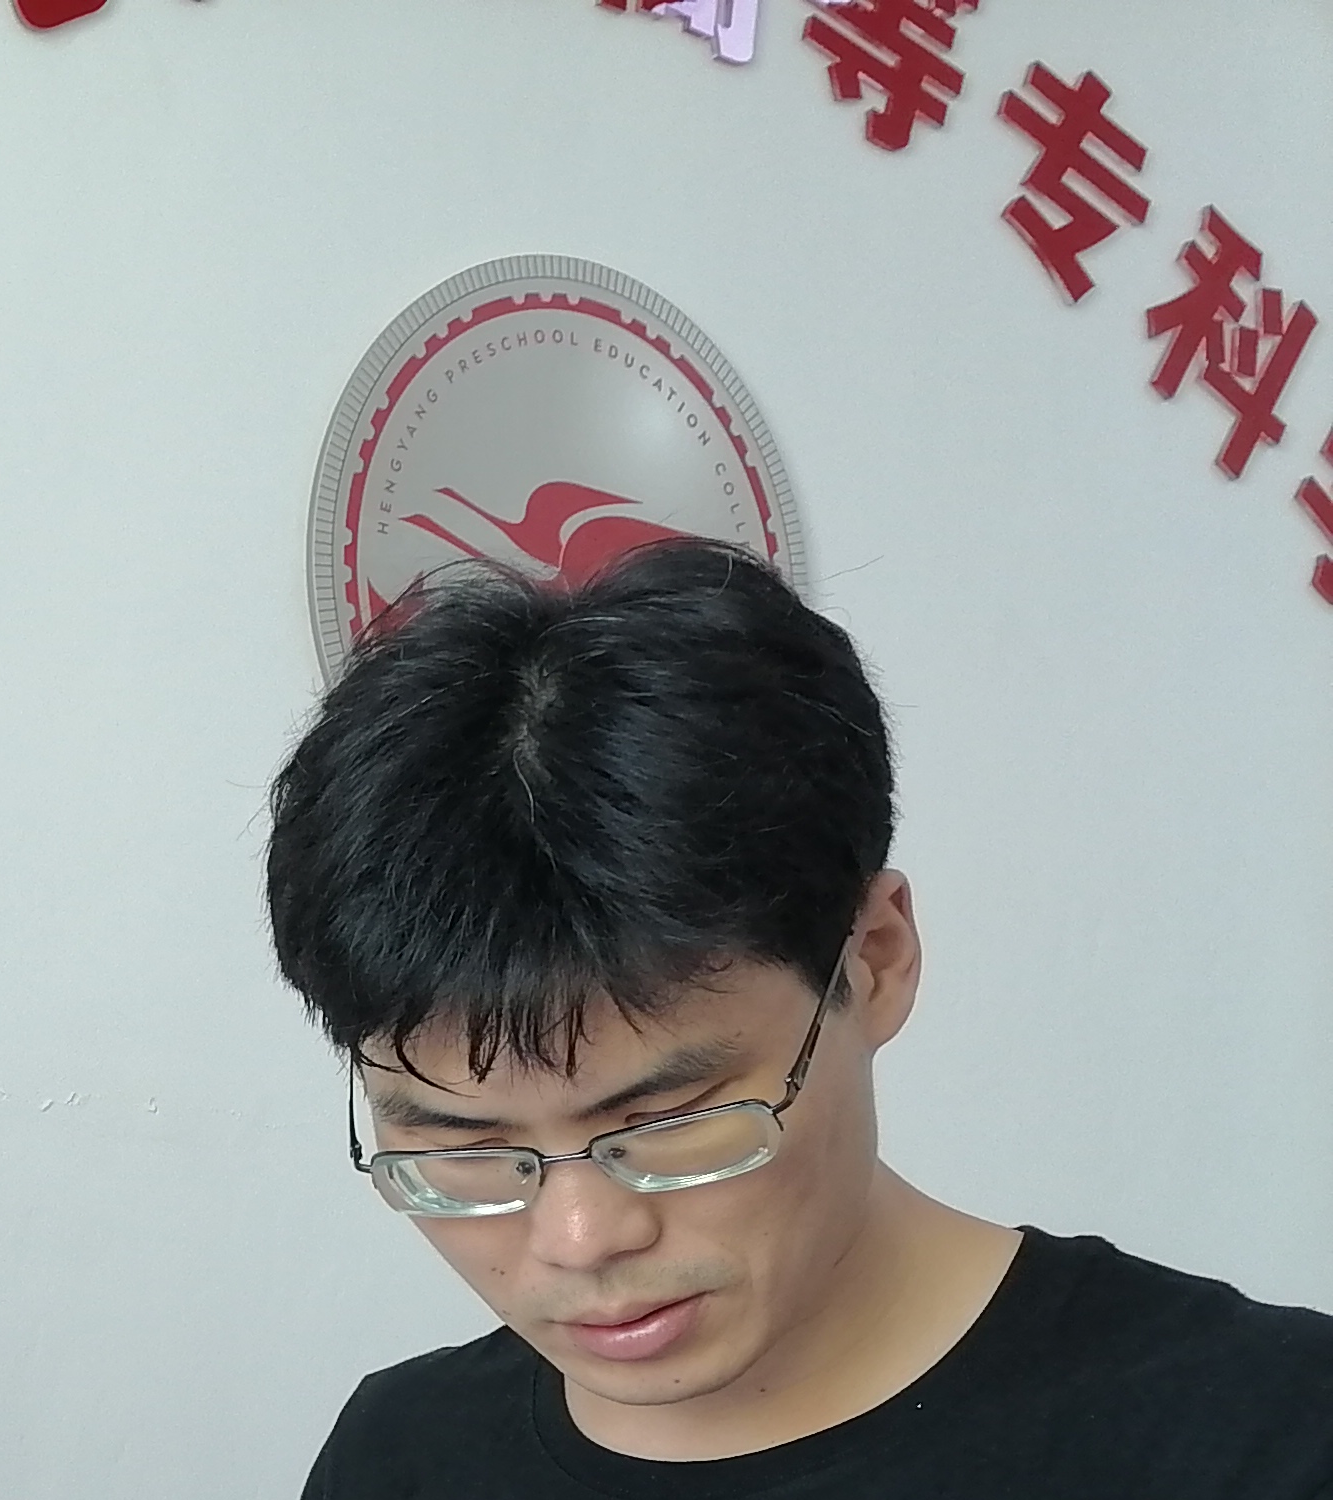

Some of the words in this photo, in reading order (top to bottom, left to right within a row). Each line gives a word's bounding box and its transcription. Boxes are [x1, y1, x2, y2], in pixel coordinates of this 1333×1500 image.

[377, 388, 440, 535] HENGYANG
[444, 328, 580, 385] PRESCHOOL
[593, 337, 711, 447] EDUCATION
